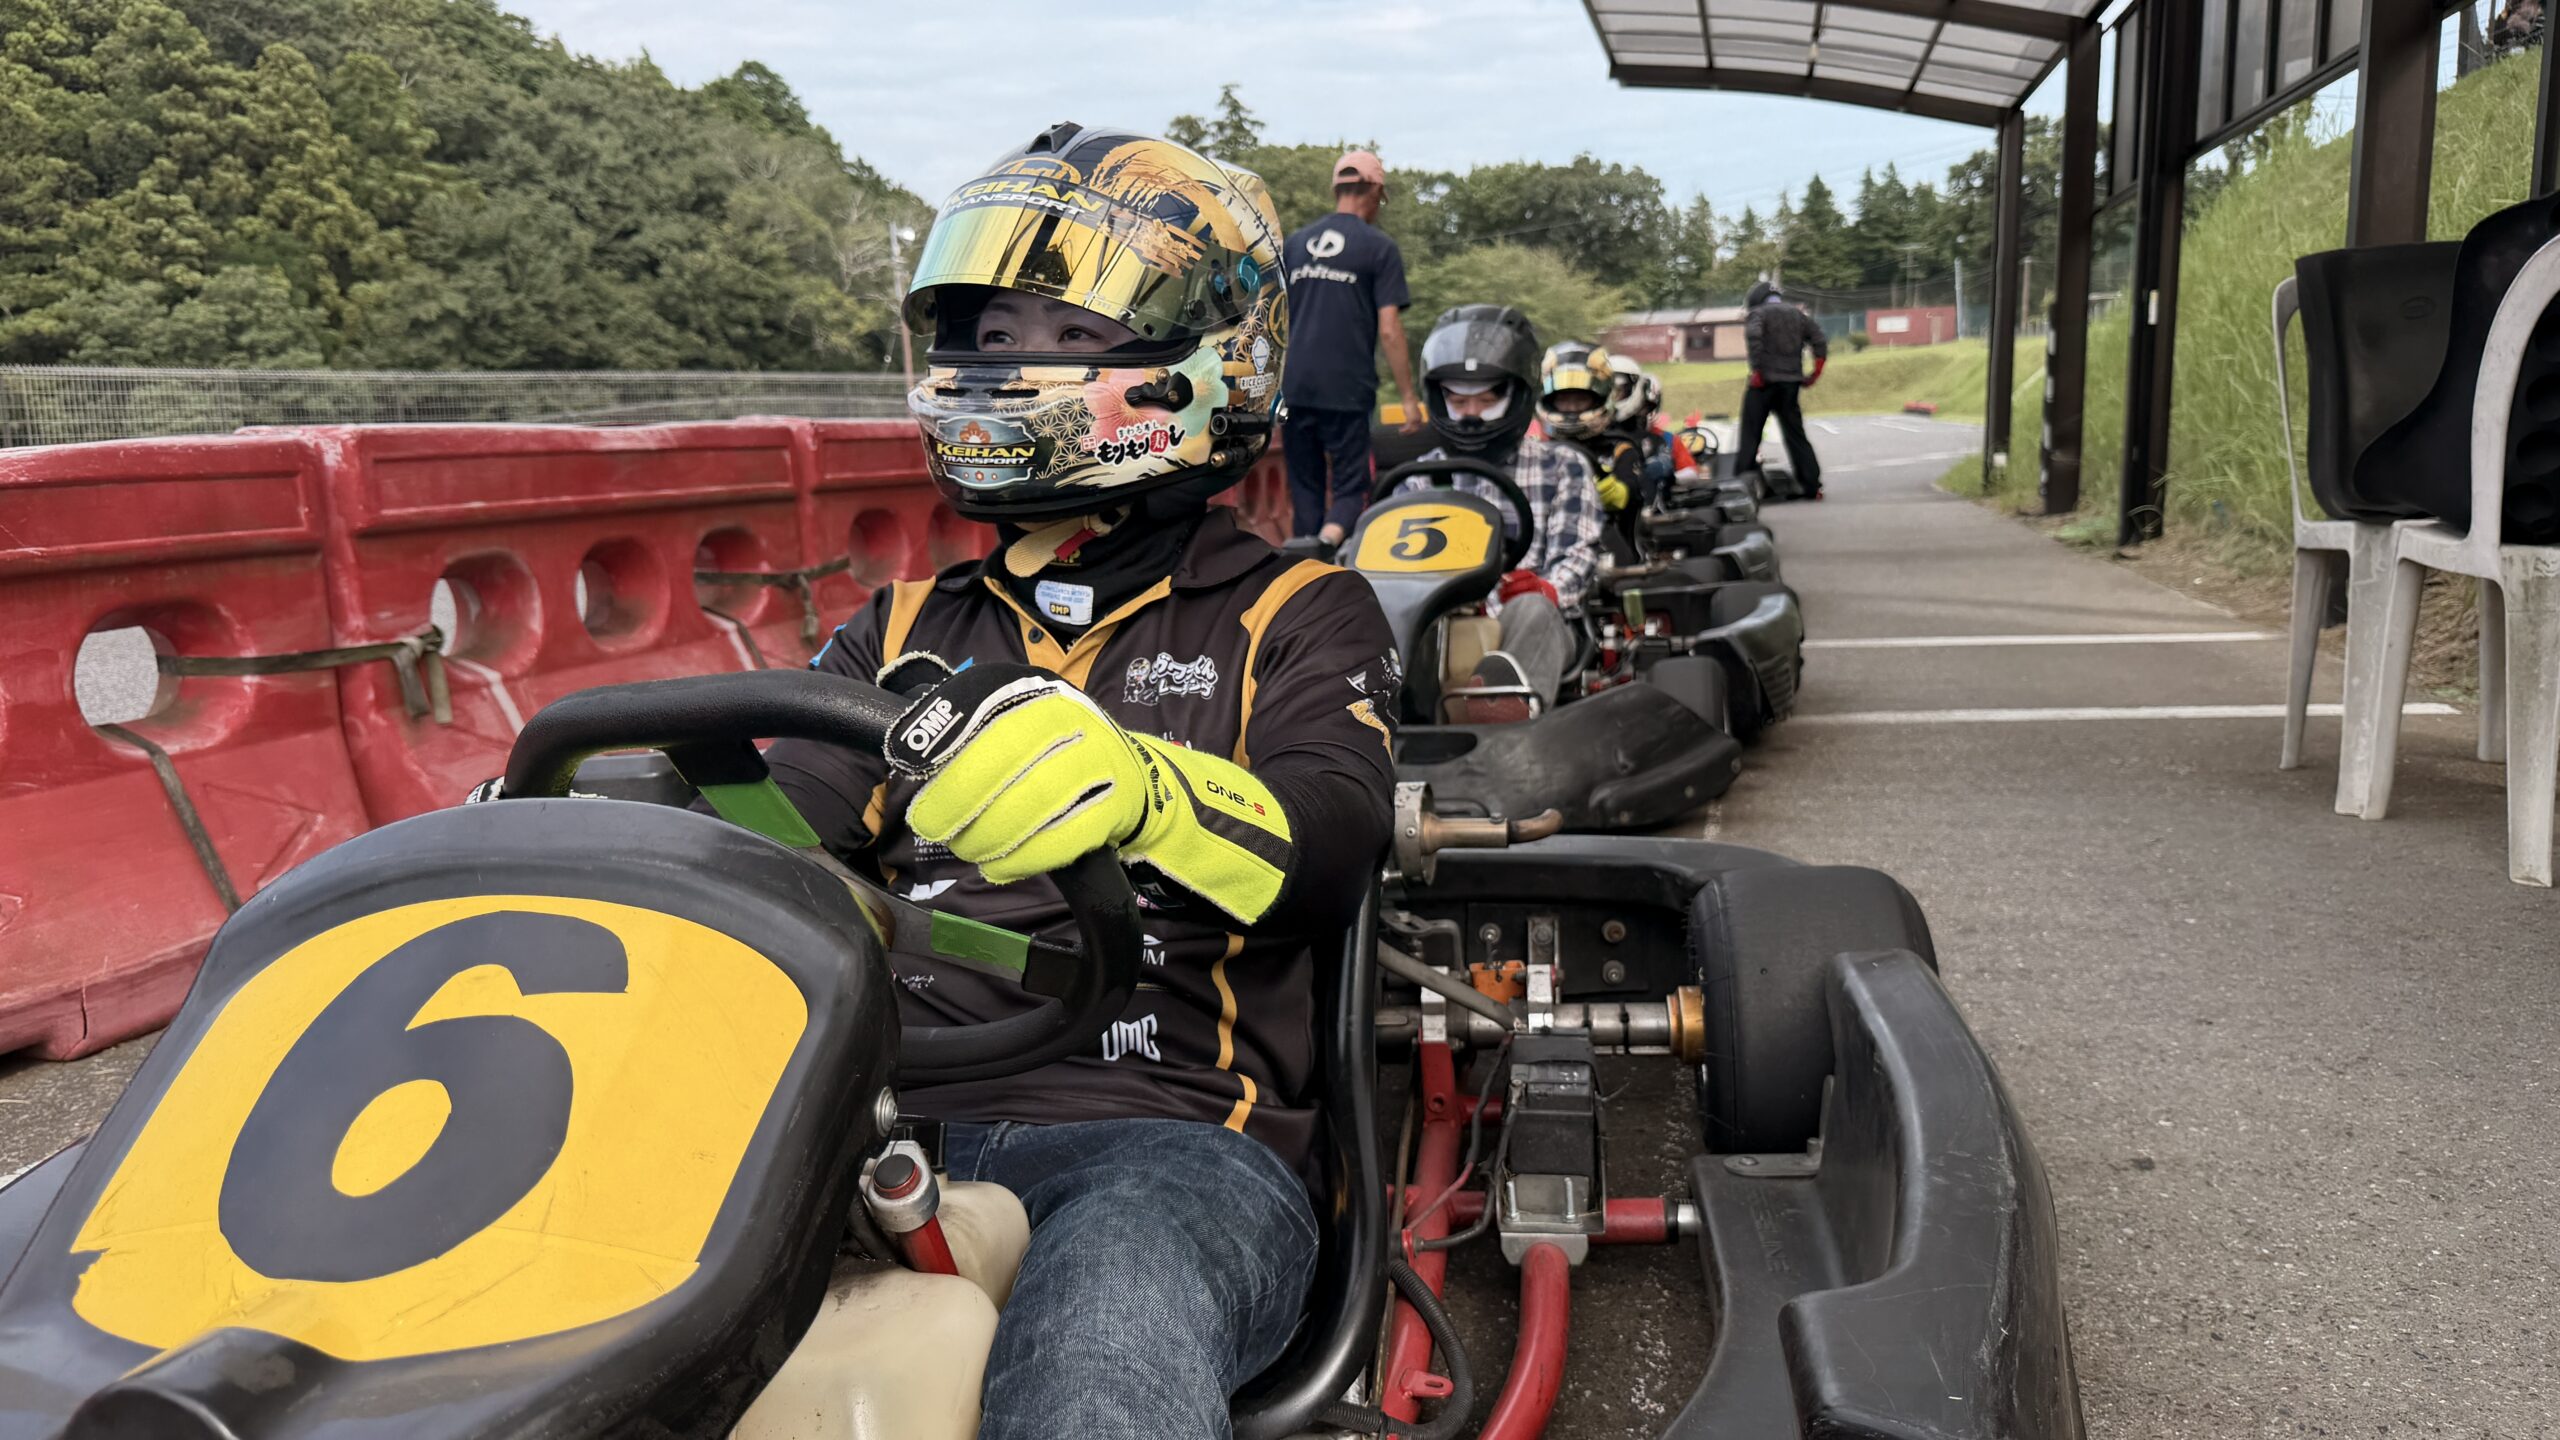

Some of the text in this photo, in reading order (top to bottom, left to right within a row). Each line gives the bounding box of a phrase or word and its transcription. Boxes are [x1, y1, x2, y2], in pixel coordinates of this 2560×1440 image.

[936, 443, 1036, 457] KEIHAN
[942, 454, 1028, 465] TRANSPORT
[1096, 424, 1186, 465] もりもり寿し
[1390, 515, 1455, 562] 5
[1050, 604, 1070, 615] OMP
[907, 699, 953, 751] OMP
[1102, 1013, 1161, 1062] UMC
[218, 909, 629, 1283] 6
